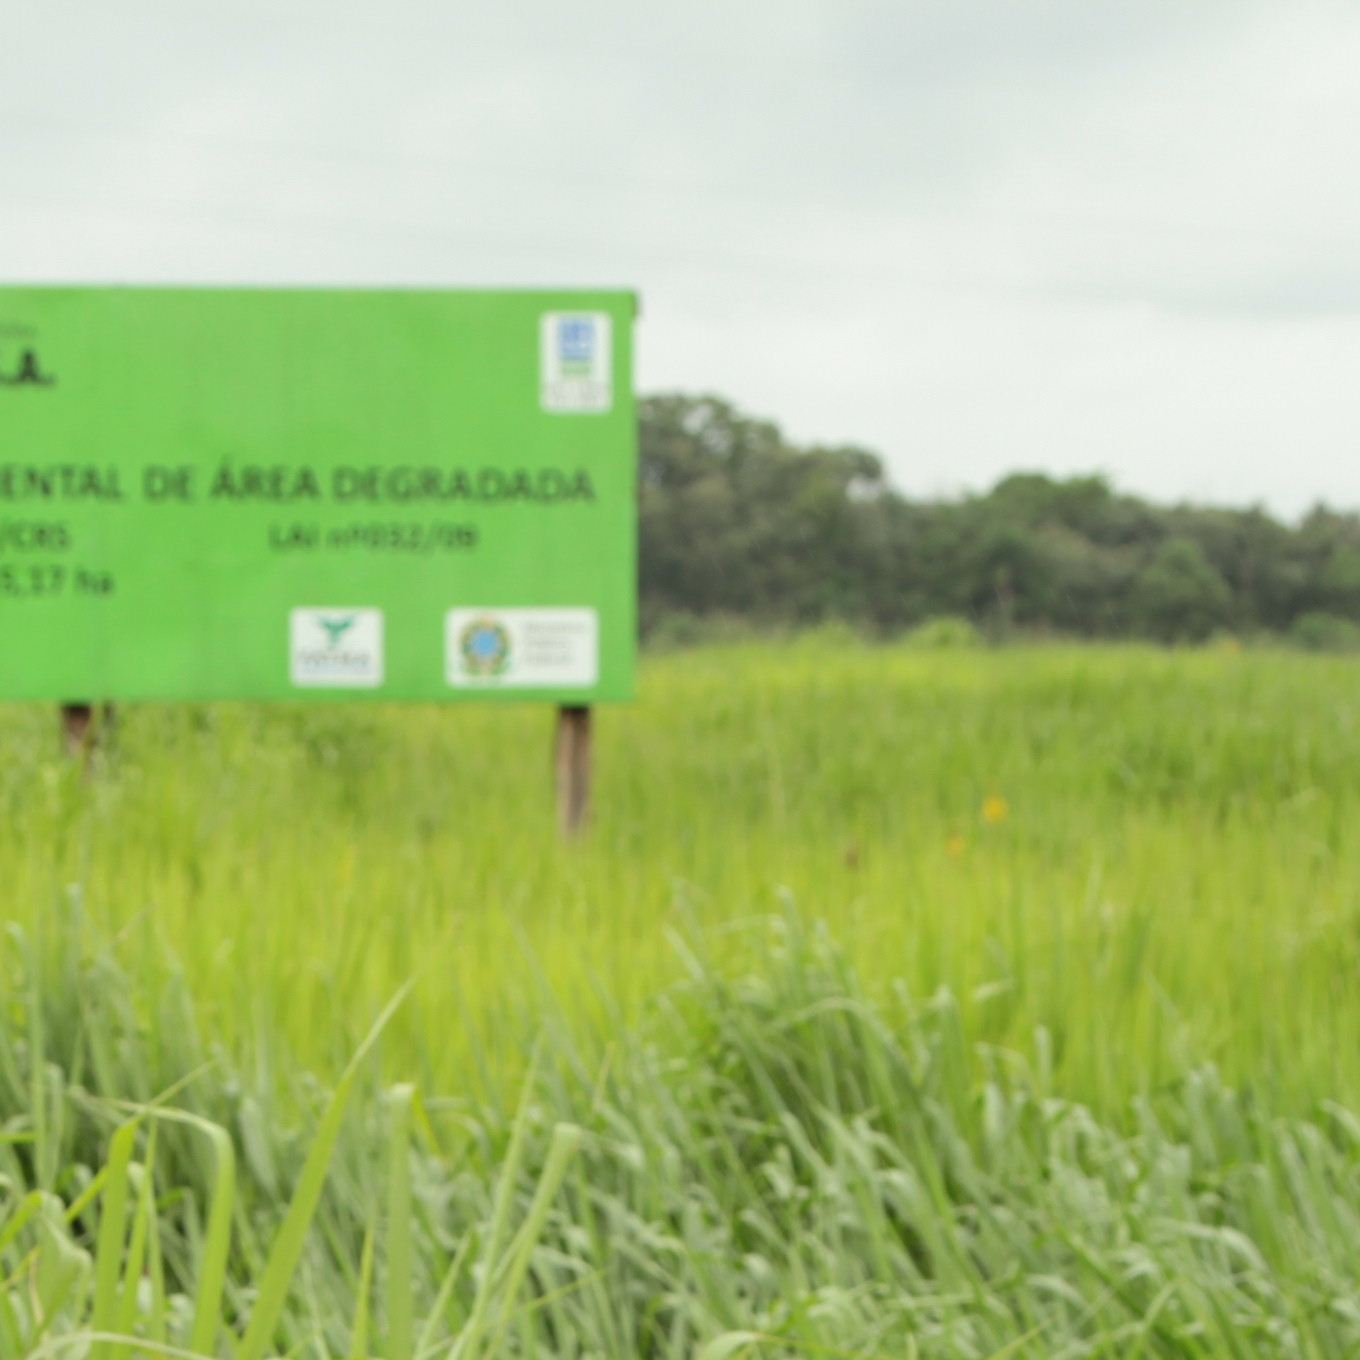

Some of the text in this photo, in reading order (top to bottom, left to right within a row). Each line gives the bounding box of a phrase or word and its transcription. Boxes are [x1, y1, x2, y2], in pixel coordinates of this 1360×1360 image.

[143, 464, 194, 502] DE
[209, 455, 321, 504] ÁREA
[331, 464, 596, 505] DEGRADADA
[75, 563, 115, 598] ha
